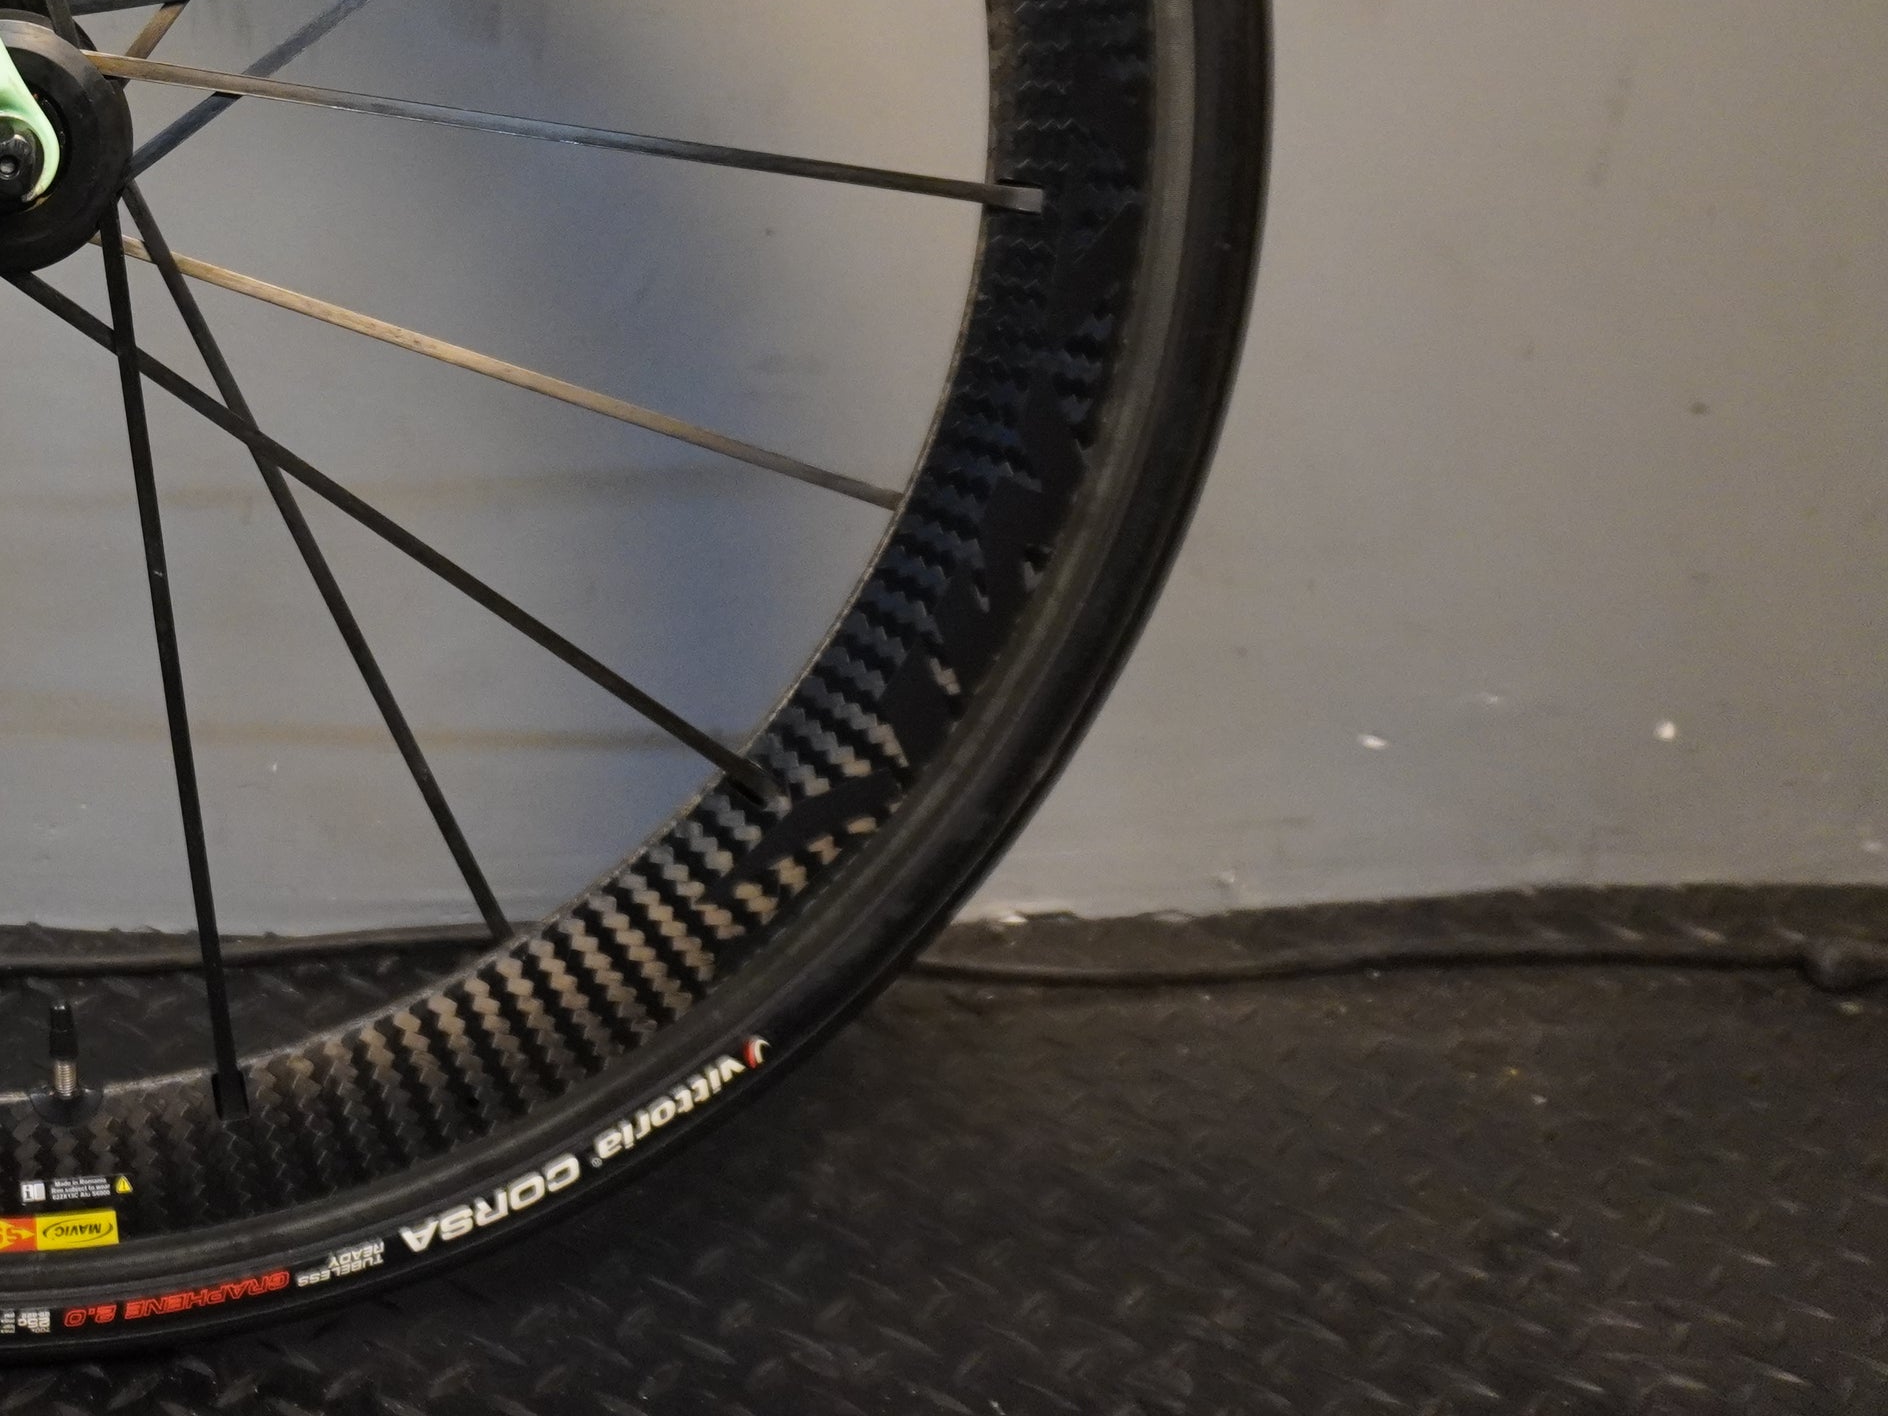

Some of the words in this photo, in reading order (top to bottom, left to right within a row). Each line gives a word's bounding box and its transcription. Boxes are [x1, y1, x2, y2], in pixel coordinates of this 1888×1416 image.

[593, 1054, 747, 1161] vittoria
[398, 1153, 581, 1254] CORSA
[54, 1222, 102, 1238] MAVIC
[297, 1253, 384, 1287] TUBELESS
[327, 1241, 385, 1269] READY
[124, 1271, 290, 1320] GRAPHENE
[64, 1304, 117, 1328] 2.0
